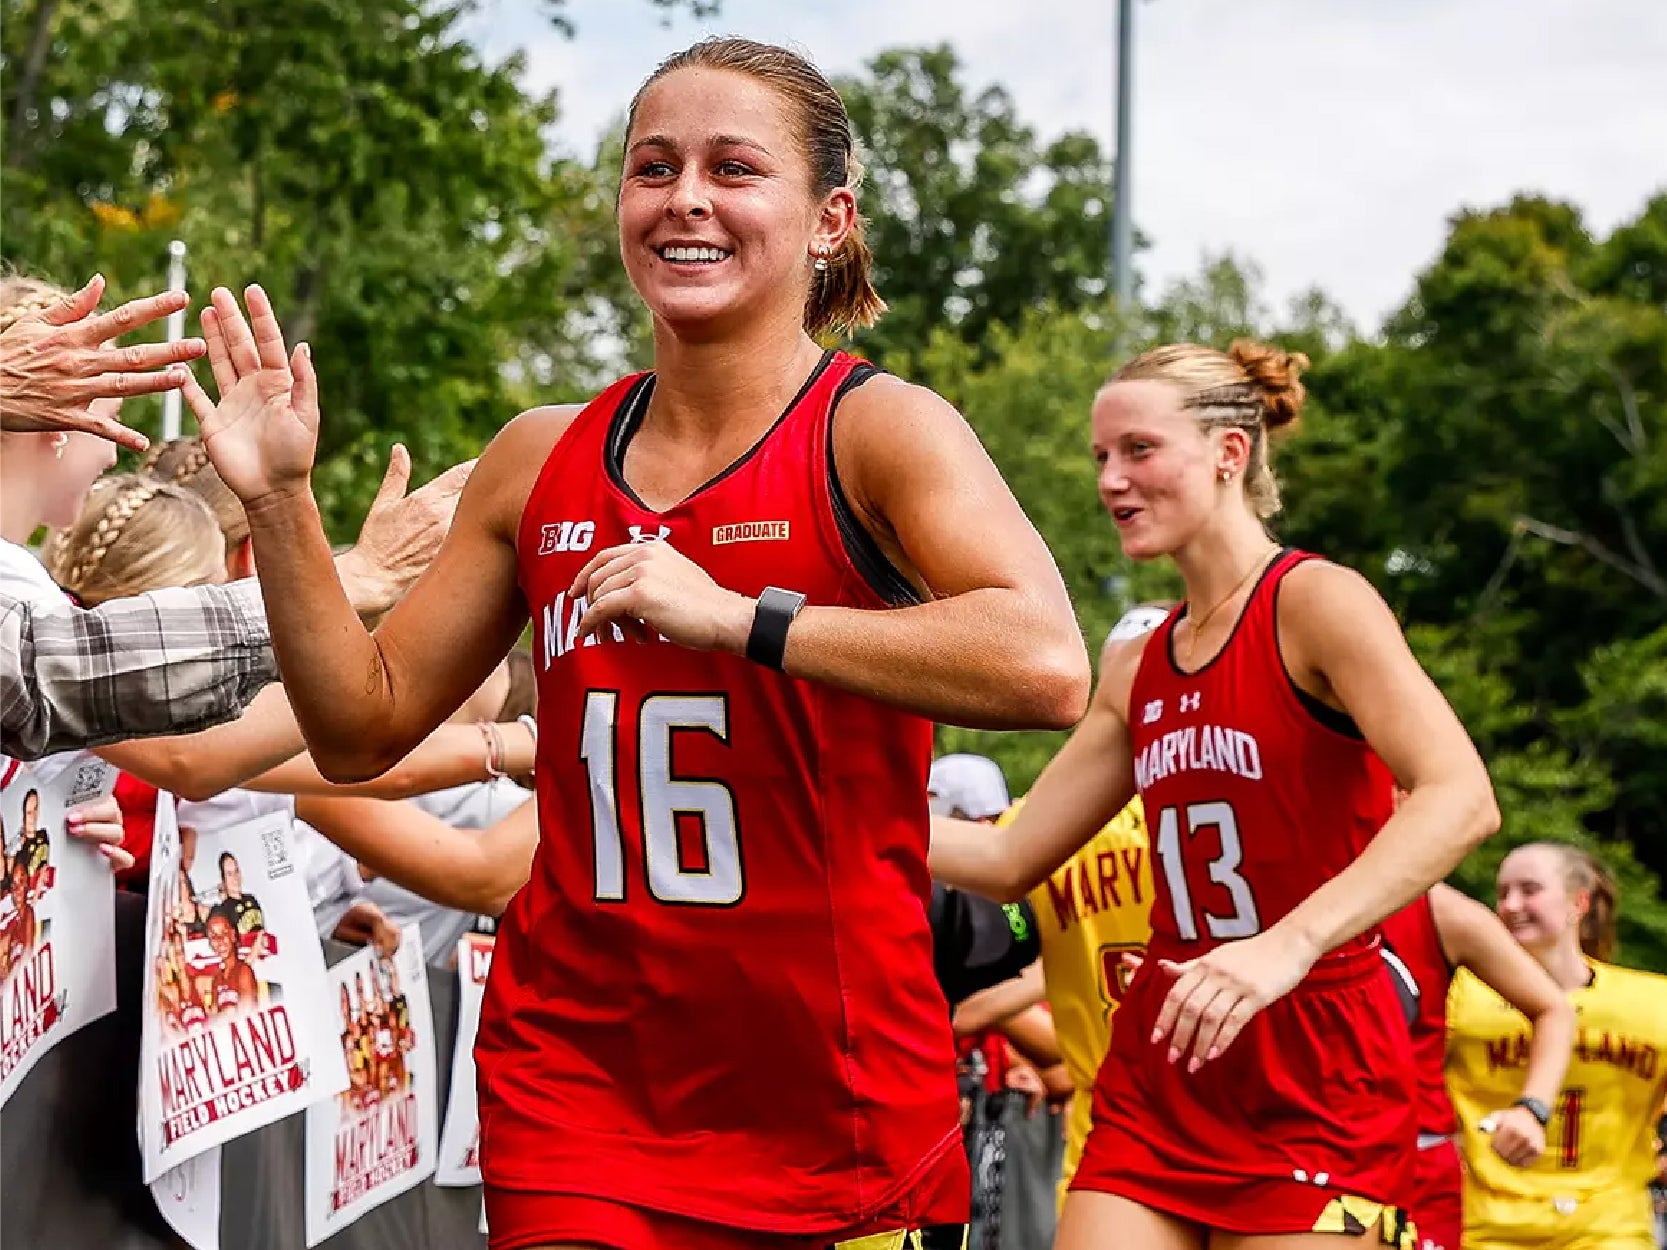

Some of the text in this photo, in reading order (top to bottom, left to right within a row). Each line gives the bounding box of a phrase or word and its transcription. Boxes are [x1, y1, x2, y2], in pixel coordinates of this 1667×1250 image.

[715, 521, 788, 543] GRADUATE
[579, 688, 746, 908] 16
[1134, 725, 1263, 792] MARYLAND
[1157, 801, 1260, 941] 13
[158, 1006, 296, 1120] MARYLAND
[213, 1068, 291, 1119] HOCKEY
[1558, 1089, 1586, 1168] 1
